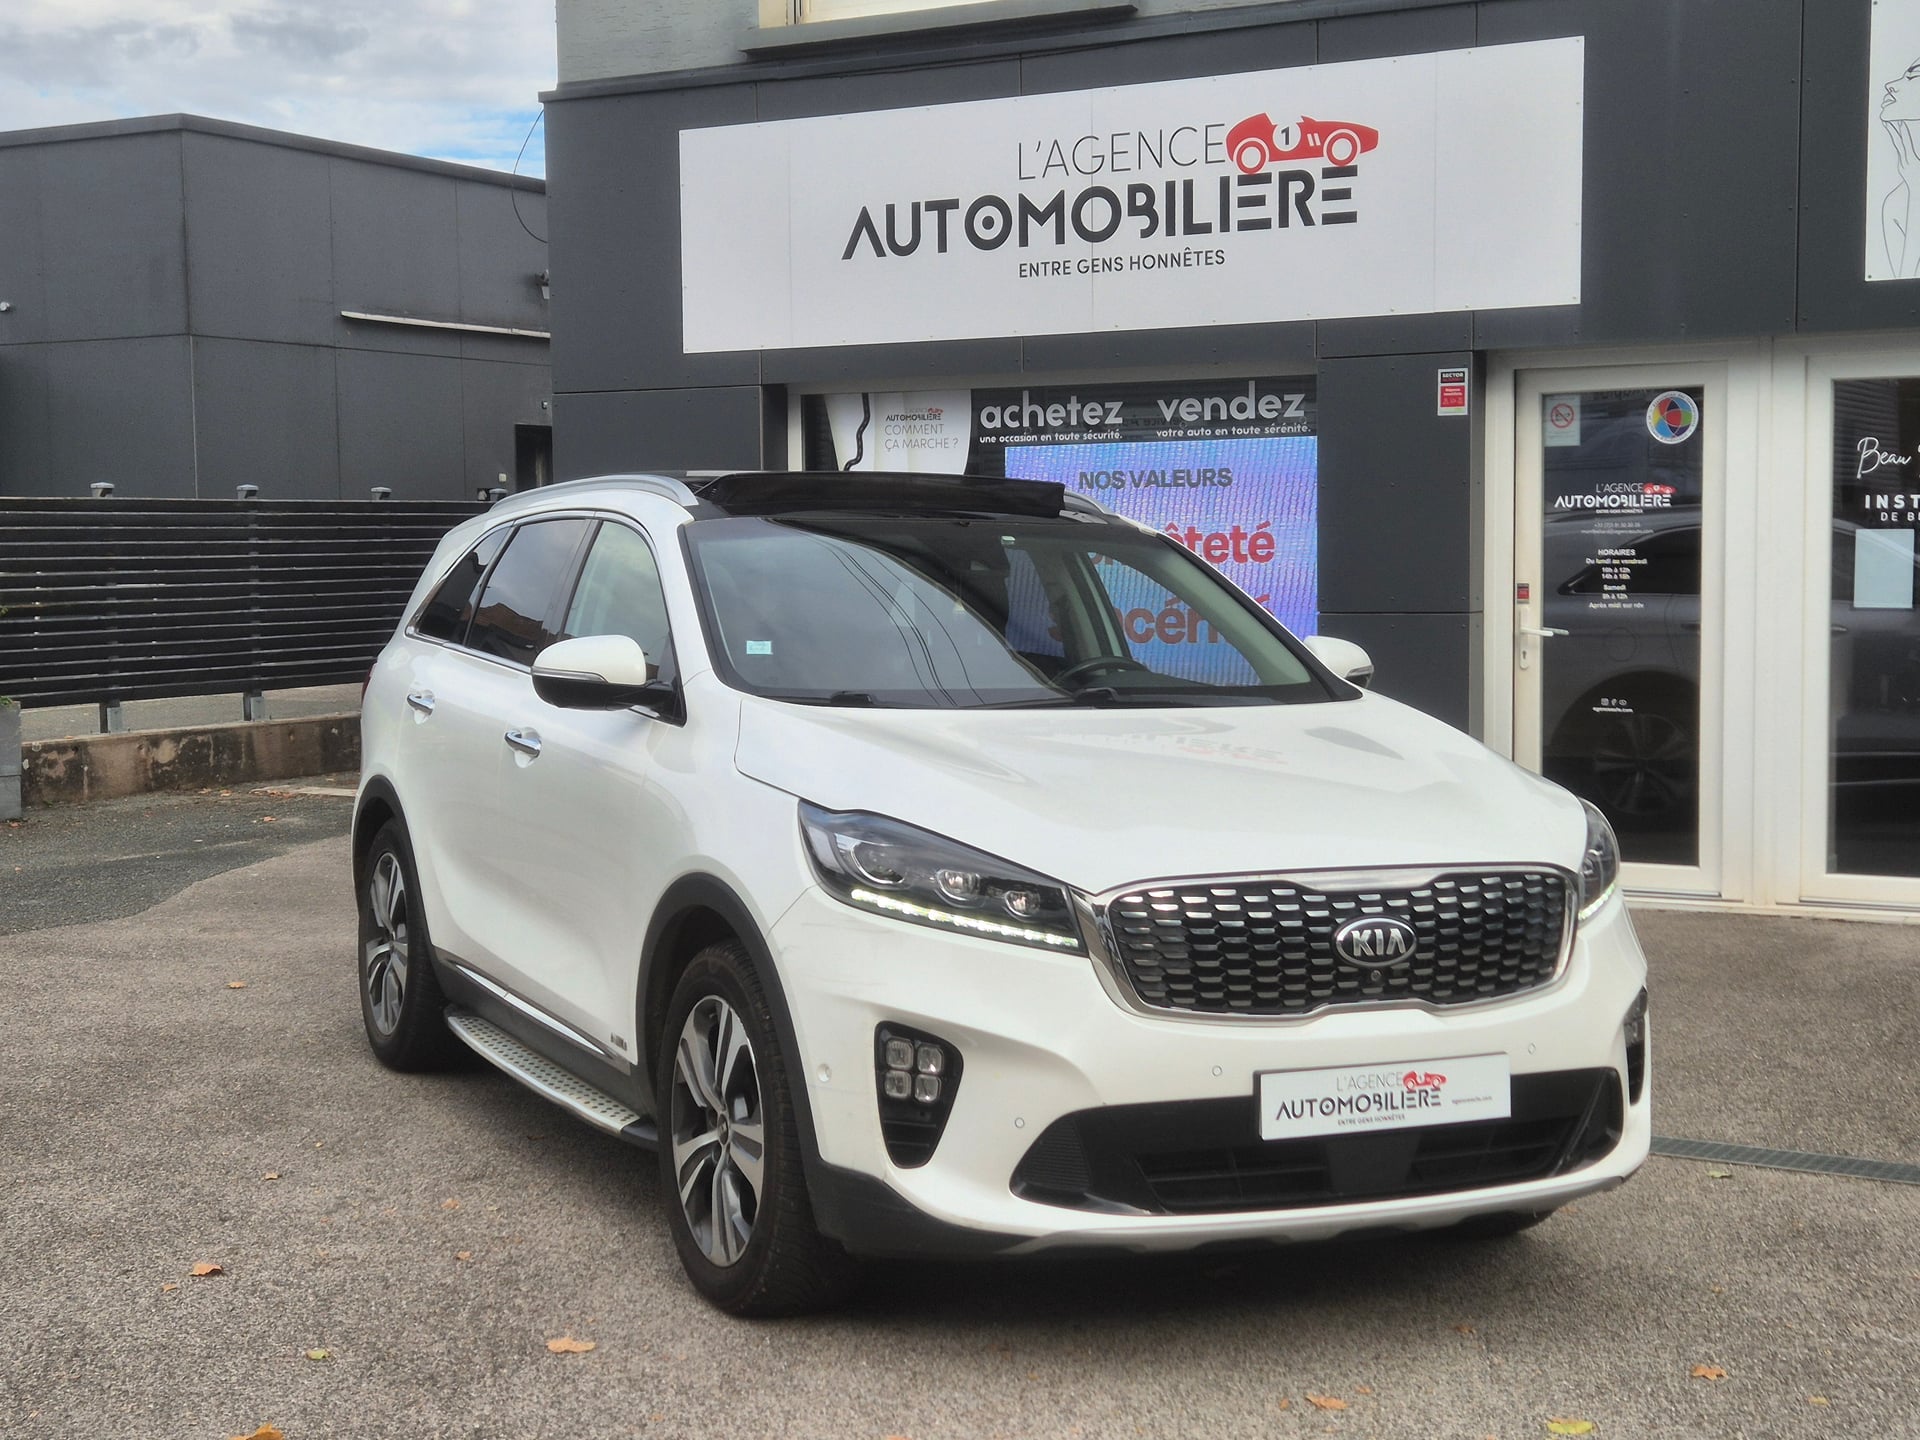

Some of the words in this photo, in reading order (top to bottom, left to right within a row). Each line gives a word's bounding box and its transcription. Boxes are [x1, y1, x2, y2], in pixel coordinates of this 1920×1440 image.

[1018, 122, 1226, 181] L'AGENCE
[1018, 259, 1072, 279] ENTRE
[1076, 256, 1124, 275] GENS
[1129, 246, 1226, 272] HONNÊTES
[980, 390, 1124, 429] achetez
[1156, 380, 1306, 423] vendez
[884, 423, 945, 436] COMMENT
[979, 436, 997, 444] une
[999, 432, 1038, 442] occasion
[1040, 433, 1052, 442] en
[1055, 431, 1080, 441] toute
[1083, 428, 1123, 440] sécurité.
[1156, 427, 1184, 438] votre
[1187, 427, 1212, 437] auto
[1215, 427, 1229, 436] en
[1231, 425, 1261, 435] toute
[1264, 421, 1312, 434] sérénité.
[884, 438, 900, 452] ÇA
[902, 437, 950, 449] MARCHE
[952, 437, 959, 449] ?
[1856, 436, 1912, 479] Beau
[1078, 470, 1126, 490] NOS
[1129, 467, 1234, 488] VALEURS
[1595, 482, 1644, 493] L'AGENCE
[1880, 511, 1898, 521] DE
[1597, 548, 1636, 556] HORAIRES
[1351, 928, 1407, 957] KIA
[1335, 1071, 1403, 1092] L'AGENCE
